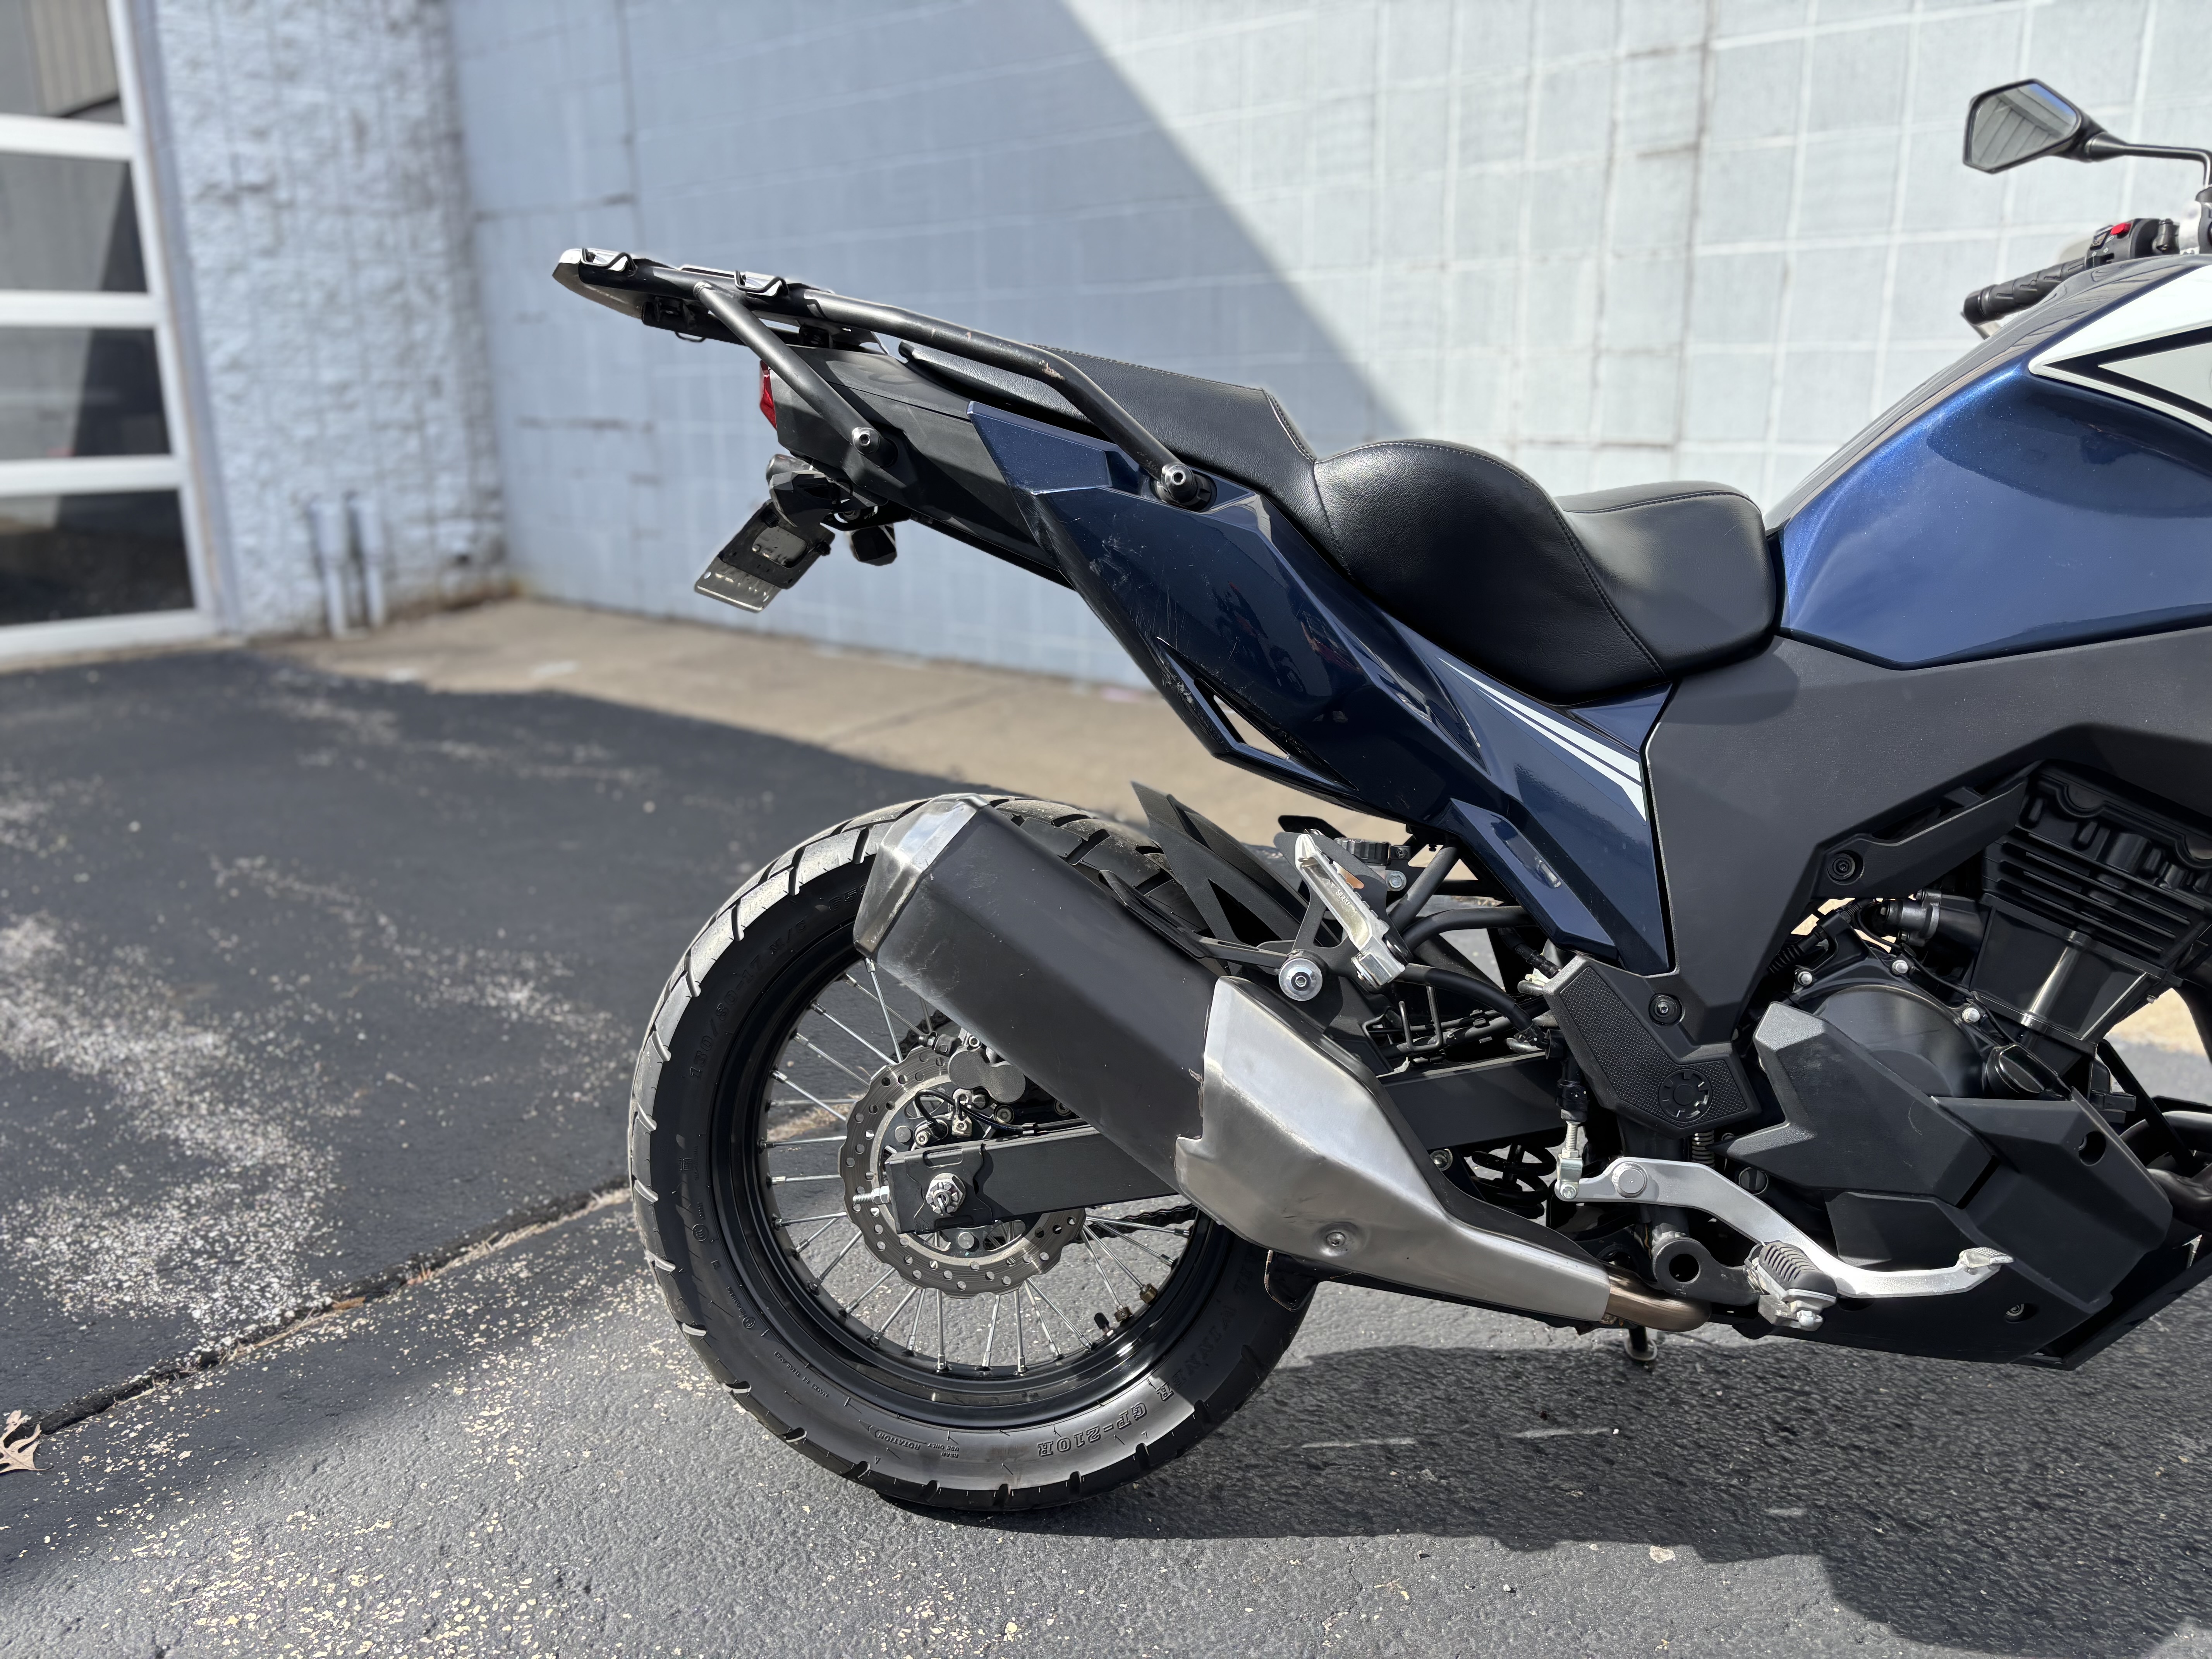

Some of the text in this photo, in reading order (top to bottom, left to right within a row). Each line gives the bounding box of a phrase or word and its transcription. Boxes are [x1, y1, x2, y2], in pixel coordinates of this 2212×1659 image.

[689, 955, 763, 1079] 130/80-17
[768, 919, 807, 955] M/C
[774, 1351, 800, 1377] THAILAND
[1156, 1305, 1237, 1401] WINNER
[811, 1383, 829, 1398] MADE
[878, 1432, 921, 1450] ROTATION
[1037, 1402, 1147, 1457] GP-210R
